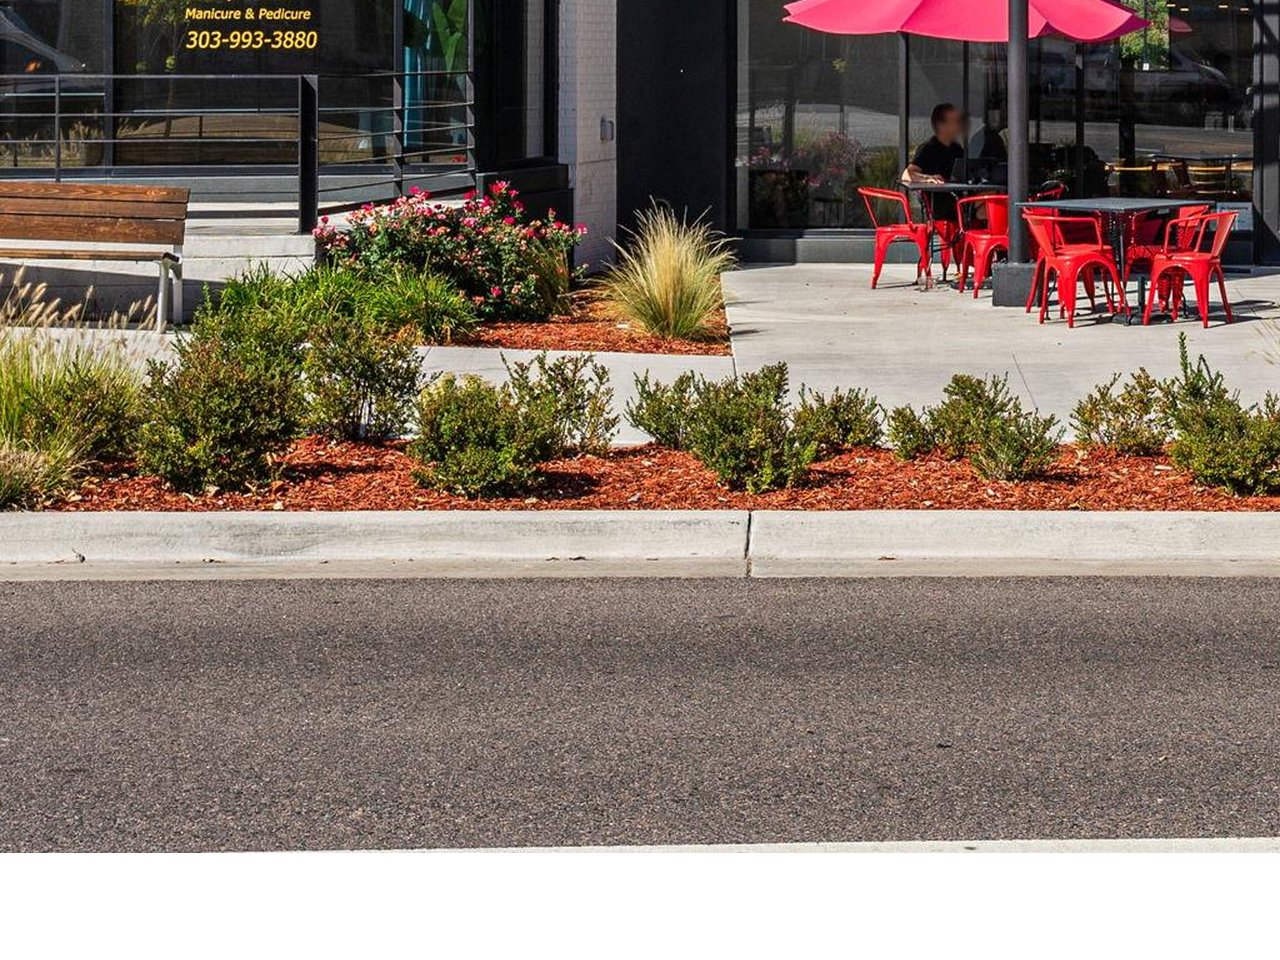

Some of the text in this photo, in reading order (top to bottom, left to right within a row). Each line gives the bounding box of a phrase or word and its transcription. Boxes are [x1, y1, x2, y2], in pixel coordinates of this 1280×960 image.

[185, 8, 311, 20] Manicure & Pedicure
[186, 30, 318, 49] 303-993-3880
